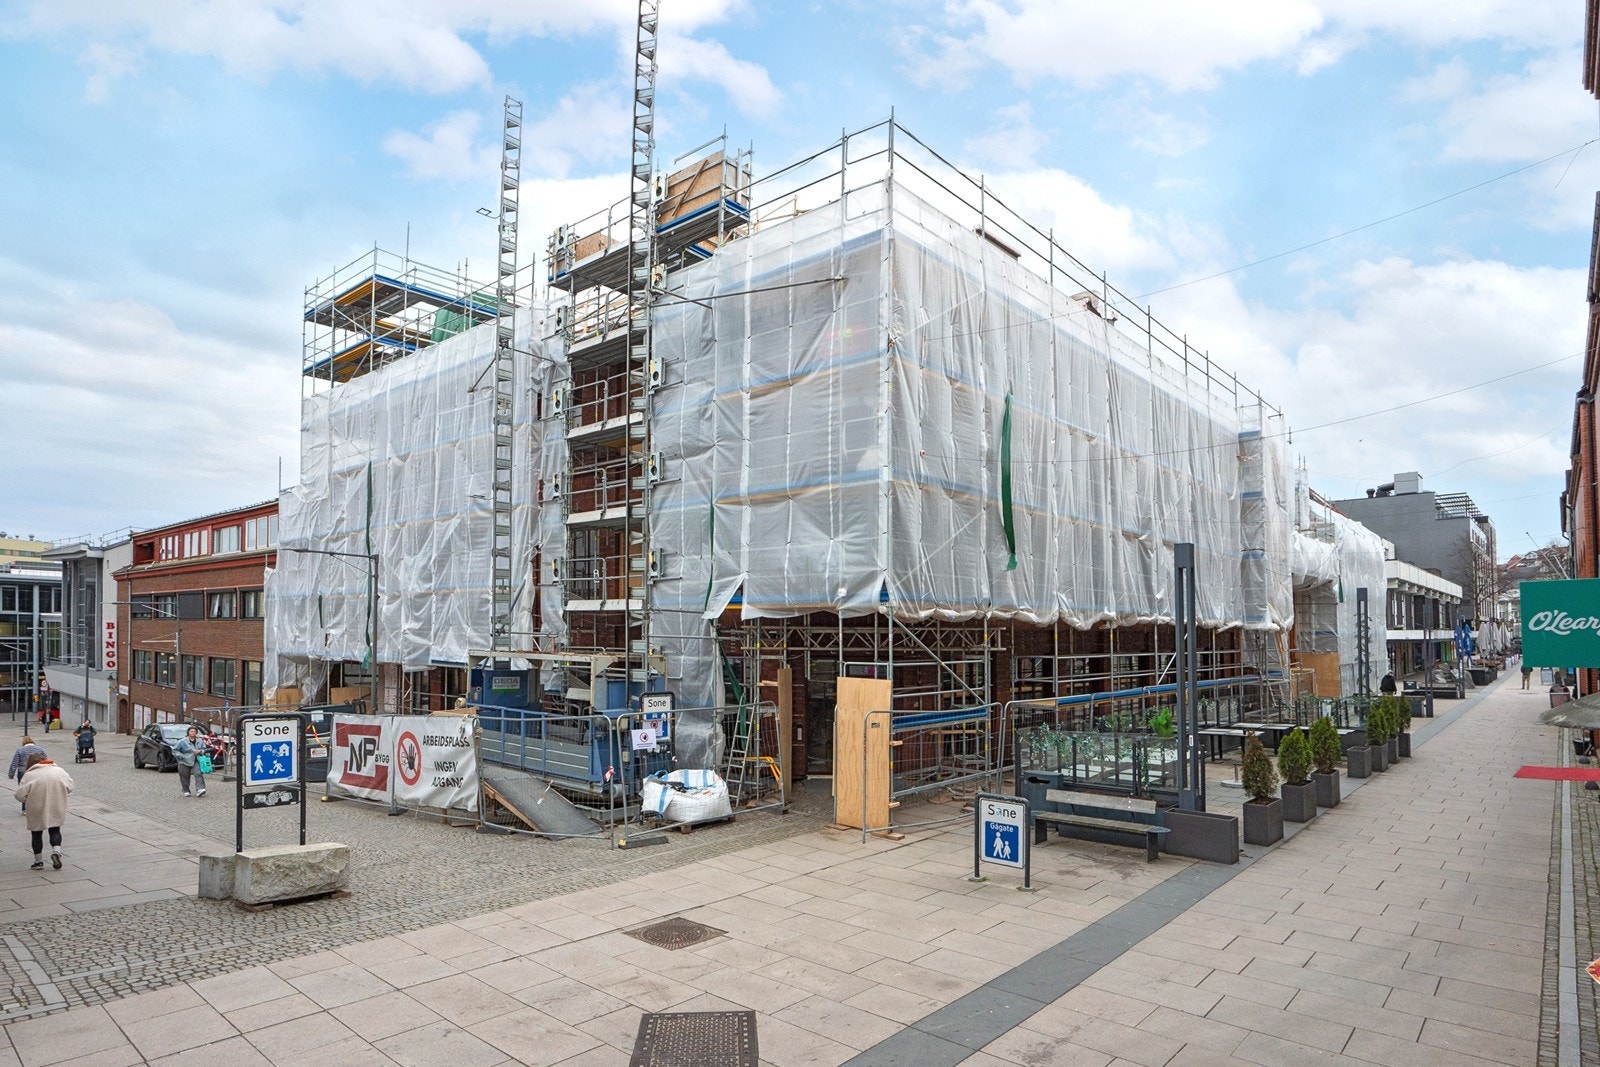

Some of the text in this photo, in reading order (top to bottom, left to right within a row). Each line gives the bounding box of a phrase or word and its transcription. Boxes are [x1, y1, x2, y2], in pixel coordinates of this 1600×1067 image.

[1528, 609, 1600, 636] O'Lear
[105, 622, 116, 668] BINGO
[648, 698, 667, 708] Sone
[254, 724, 290, 736] Sone
[423, 735, 470, 747] ARBEIDSPLASS
[348, 737, 390, 773] NP BYGG
[990, 822, 1013, 832] Gågate
